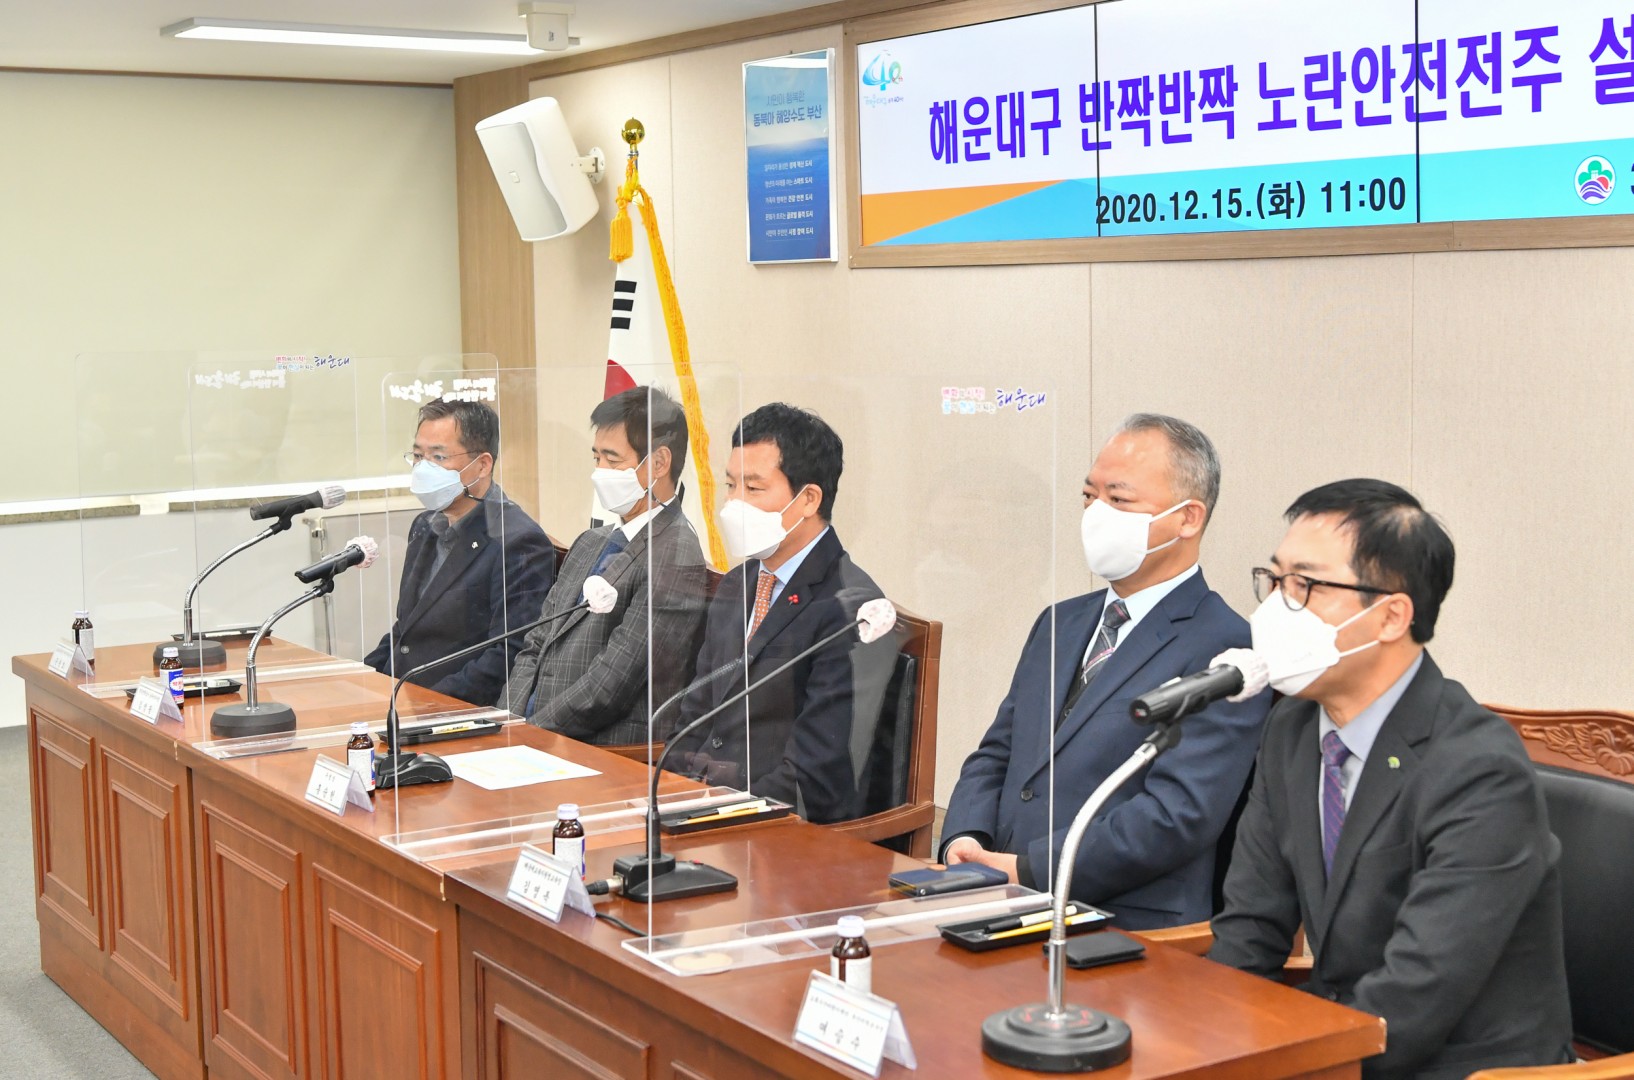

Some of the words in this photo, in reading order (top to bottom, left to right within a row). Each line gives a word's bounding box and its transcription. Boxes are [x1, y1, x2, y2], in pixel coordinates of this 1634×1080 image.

[929, 88, 1062, 164] 해운대구
[1079, 65, 1238, 151] 반짝반짝
[1257, 25, 1562, 132] 노란안전전주
[753, 112, 774, 127] 동북아
[776, 107, 805, 124] 해양수도
[807, 104, 822, 120] 부산
[1096, 180, 1305, 225] 2020.12.15.(화)
[1321, 177, 1406, 213] 11:00
[314, 355, 350, 368] 해운대
[996, 388, 1046, 411] 해운대
